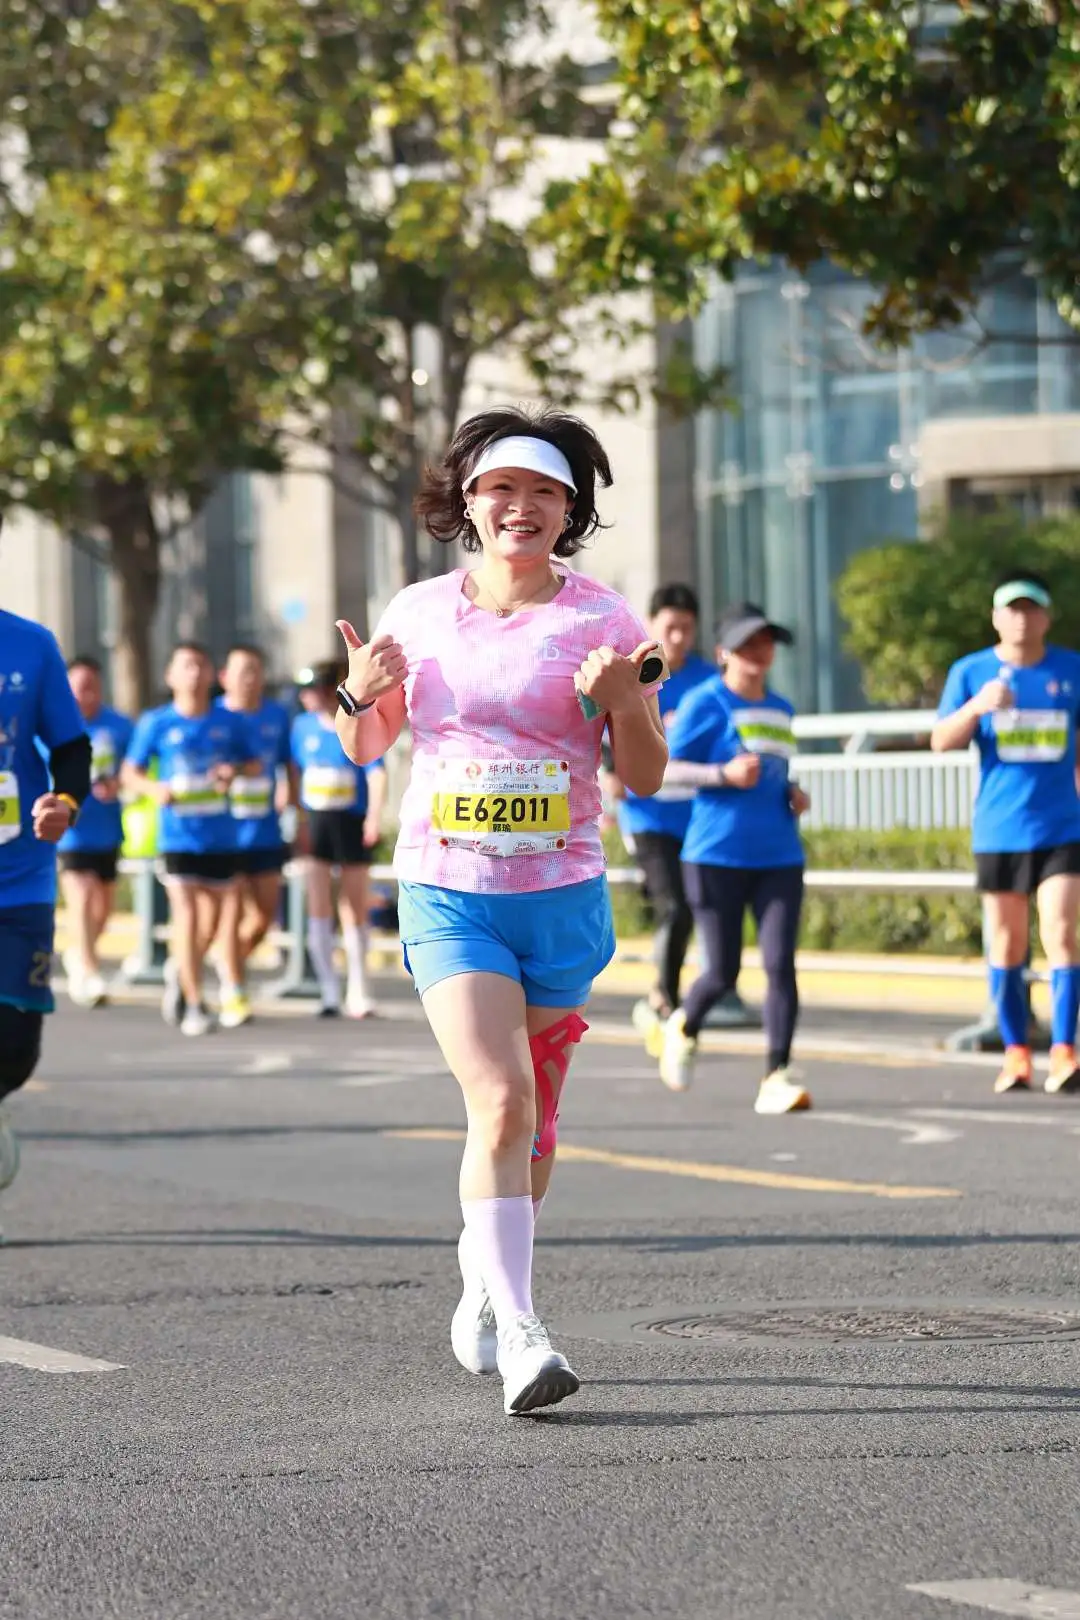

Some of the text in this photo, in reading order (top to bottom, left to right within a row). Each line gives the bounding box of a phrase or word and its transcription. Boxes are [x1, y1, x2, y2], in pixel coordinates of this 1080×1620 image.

[488, 762, 541, 776] 郑州银行
[455, 796, 549, 823] E62011
